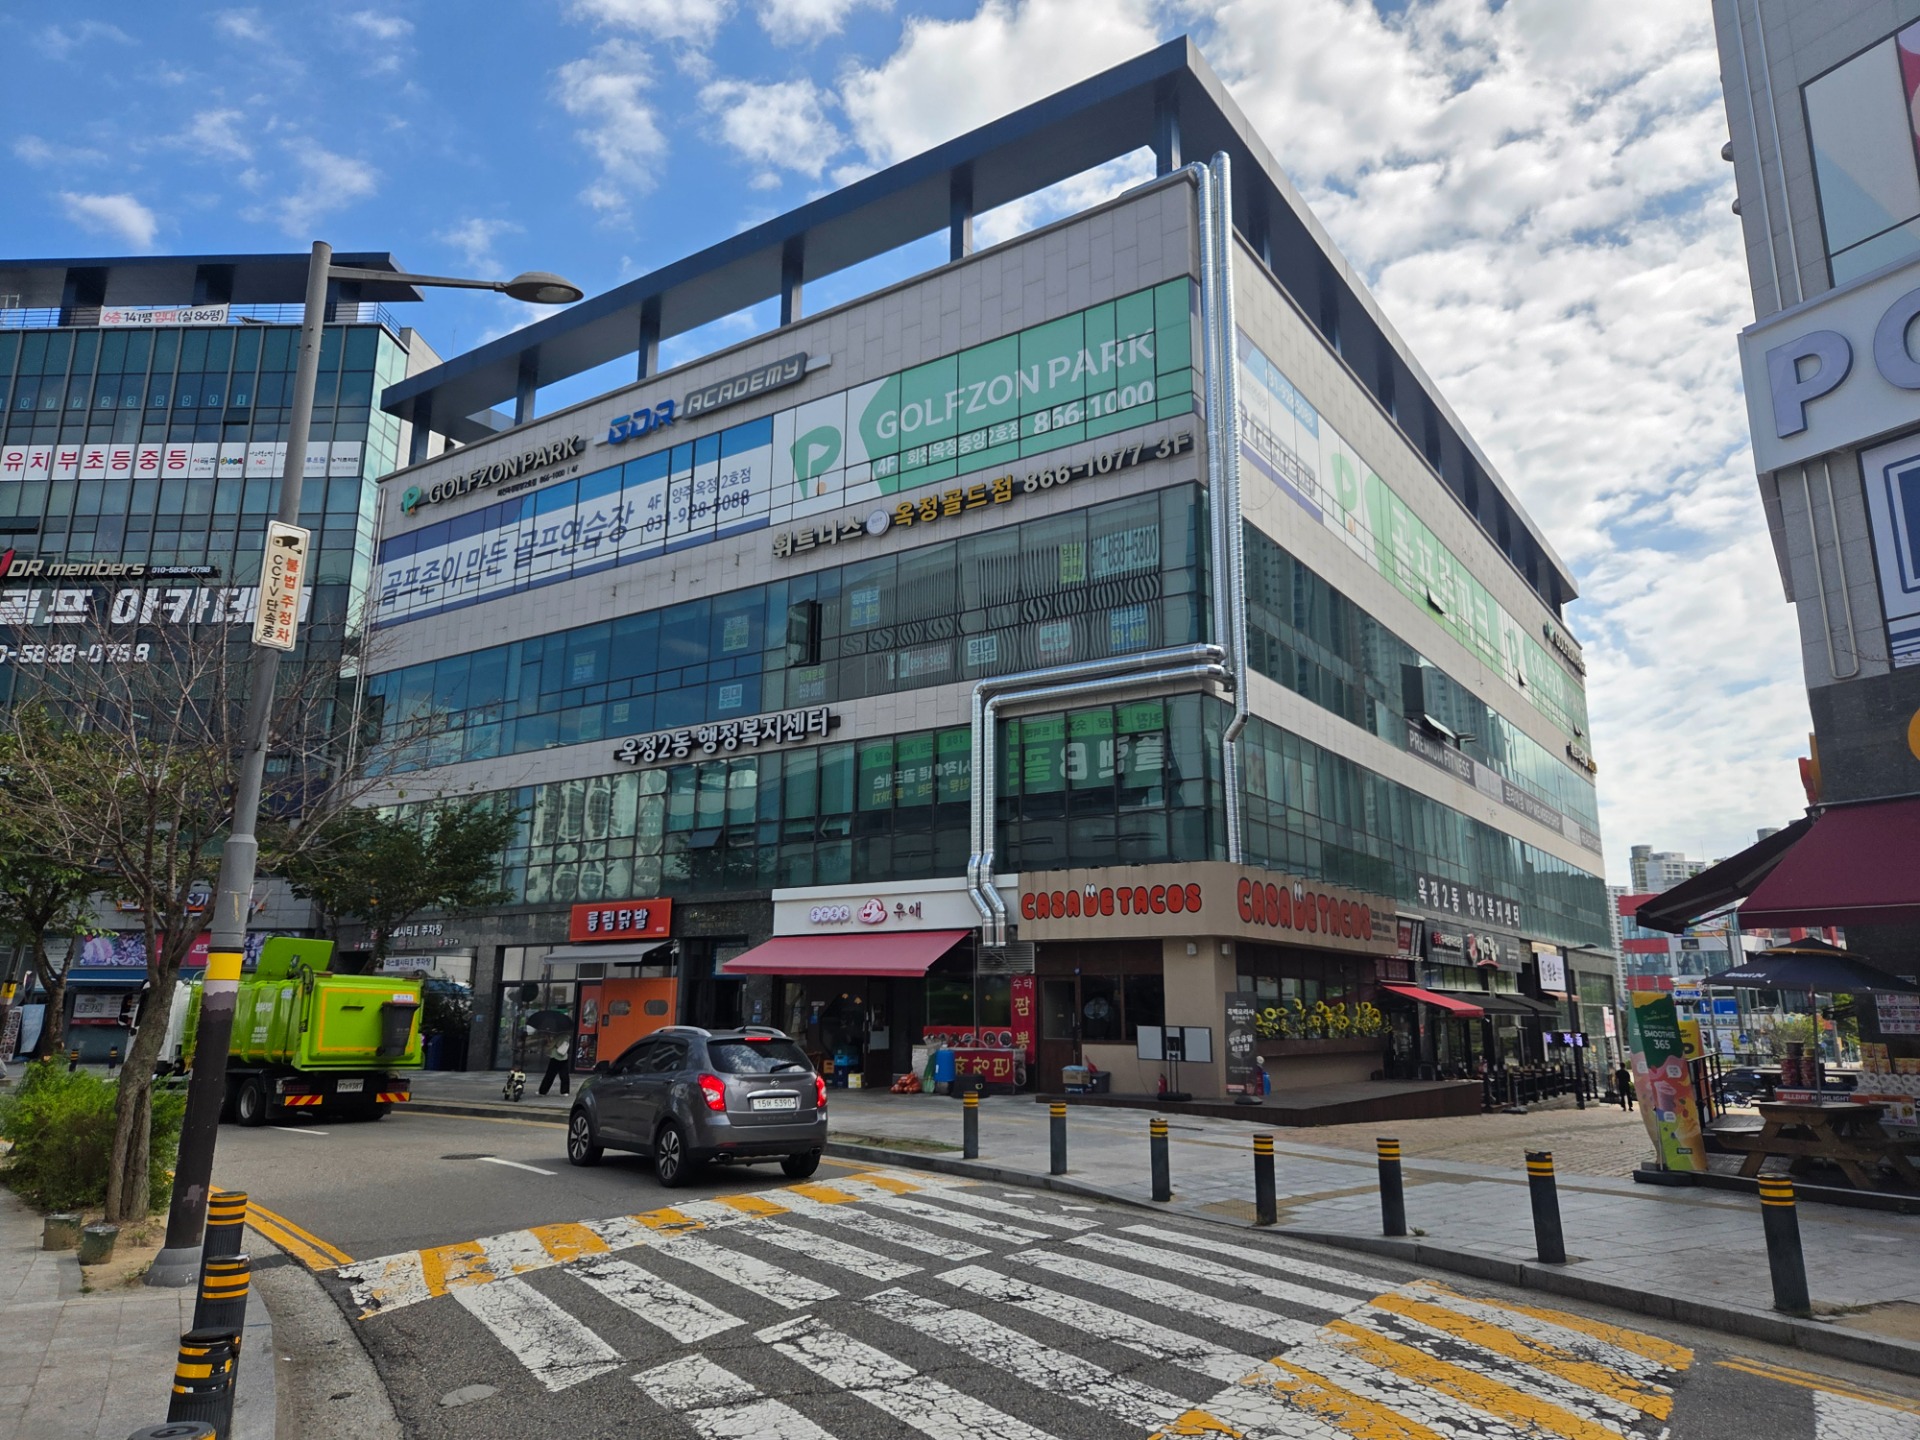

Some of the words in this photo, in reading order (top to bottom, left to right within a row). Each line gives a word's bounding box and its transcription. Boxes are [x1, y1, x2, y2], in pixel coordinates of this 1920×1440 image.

[103, 312, 122, 323] 6층
[124, 312, 152, 323] 141평
[154, 311, 176, 322] 임대
[195, 310, 224, 322] 86평)
[687, 359, 799, 414] ACADEMY
[876, 364, 1040, 440] GOLFZON
[1048, 328, 1156, 388] PARK
[876, 456, 897, 475] 4F
[1033, 381, 1157, 434] 866-1000
[428, 456, 519, 504] GOLFZON
[520, 434, 580, 474] PARK
[647, 493, 662, 511] 4F
[721, 466, 752, 490] 2호점
[773, 517, 863, 558] 휘트니스
[894, 474, 1014, 529] 옥정골드점
[1023, 442, 1144, 493] 866-1077
[1155, 430, 1192, 460] 3F
[466, 538, 508, 583] 만든
[514, 501, 635, 569] 골프연습장
[47, 560, 146, 576] members
[620, 731, 691, 764] 옥정2동
[698, 708, 828, 754] 행정복지센터
[1409, 731, 1443, 765] PREMIUM
[1444, 749, 1470, 779] FITNESS
[1021, 890, 1081, 920] CASA
[1116, 883, 1202, 916] TACOS
[1237, 877, 1291, 929] CASA
[1317, 893, 1373, 941] TACOS
[1418, 877, 1460, 913] 옥정2동
[1467, 891, 1520, 927] 행정복지센터
[421, 924, 443, 936] 주차장
[416, 957, 431, 966] 주차장
[1013, 979, 1033, 990] 수라
[1014, 996, 1031, 1051] 짬뽕
[1643, 1031, 1676, 1039] SMOOTHIE
[1654, 1039, 1671, 1050] 365
